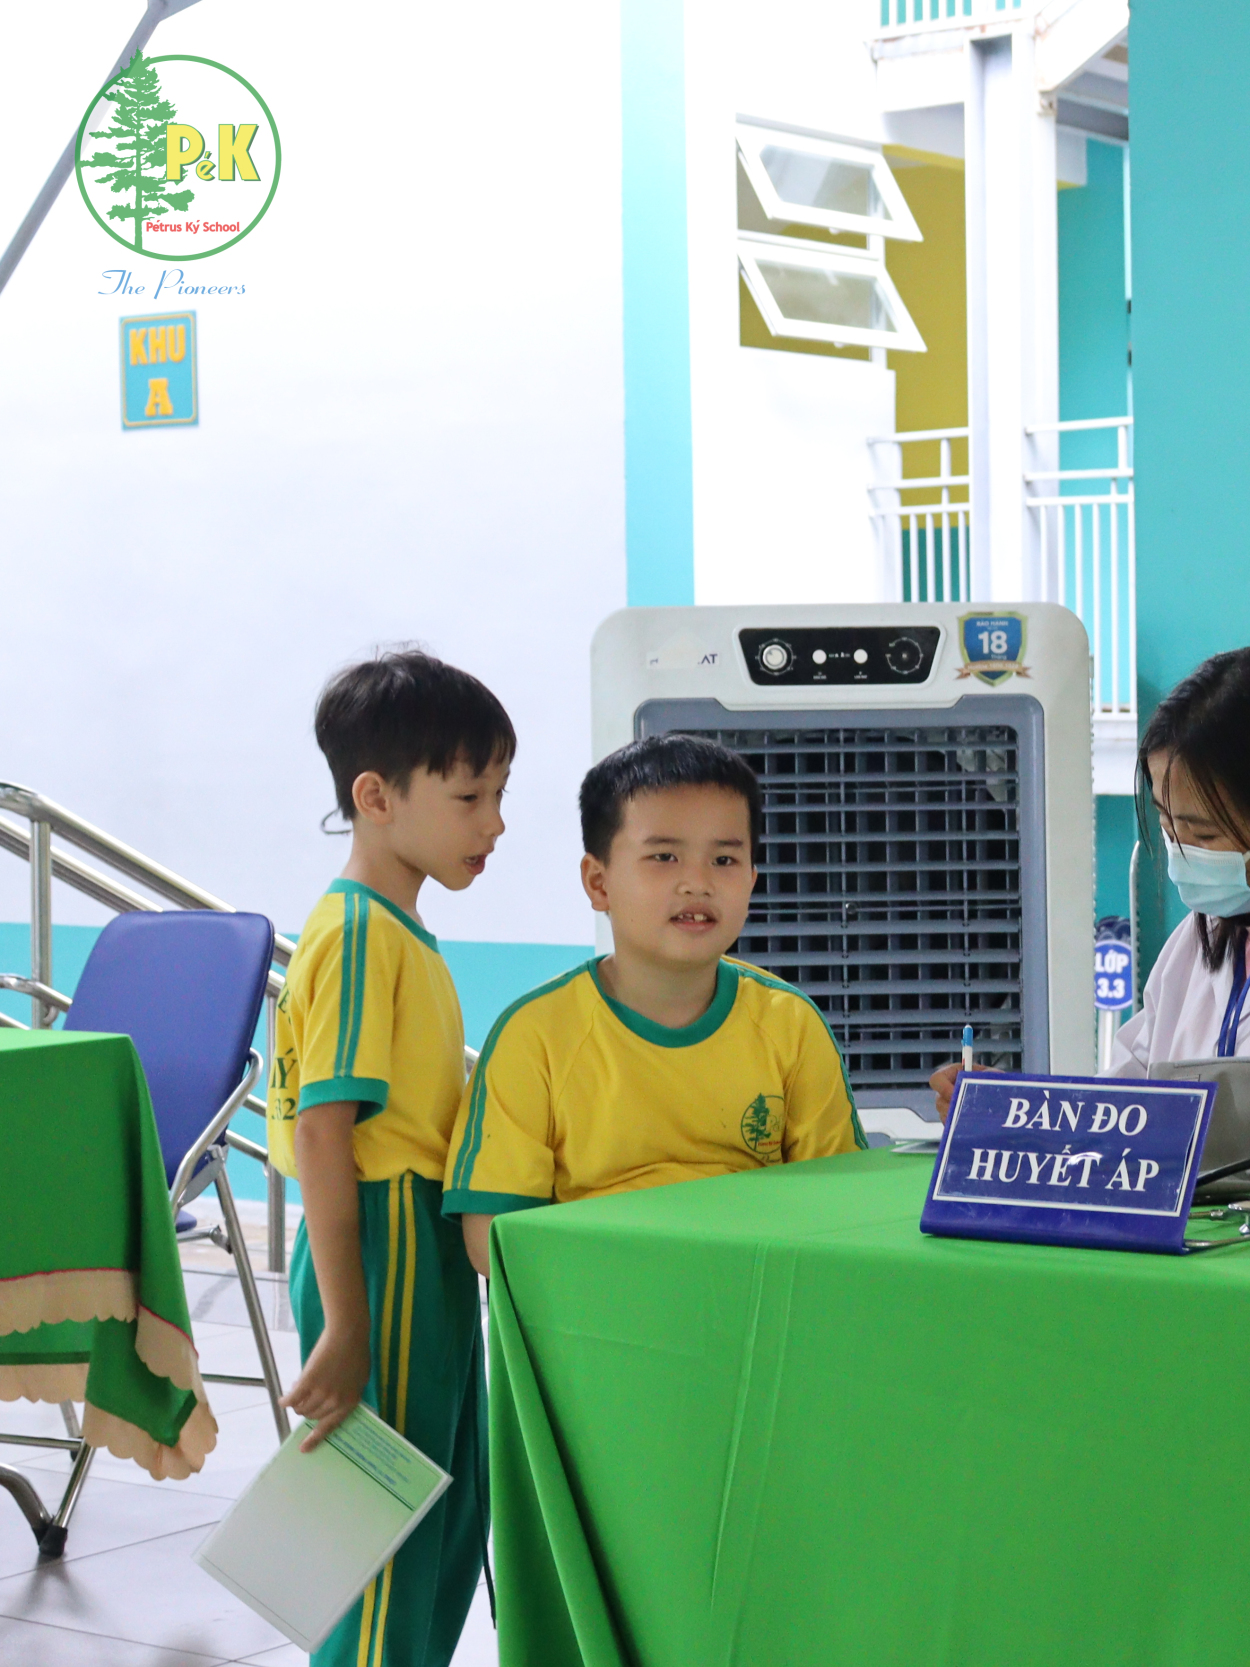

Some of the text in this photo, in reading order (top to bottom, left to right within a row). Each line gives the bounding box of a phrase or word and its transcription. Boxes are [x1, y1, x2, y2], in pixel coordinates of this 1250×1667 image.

[129, 324, 186, 366] KHU
[144, 377, 174, 417] A
[978, 630, 1008, 654] 18
[1095, 949, 1130, 974] LỚP
[1096, 977, 1126, 999] 3.3
[1002, 1090, 1148, 1136] BÀN ĐO
[965, 1144, 1160, 1192] HUYẾT ÁP
